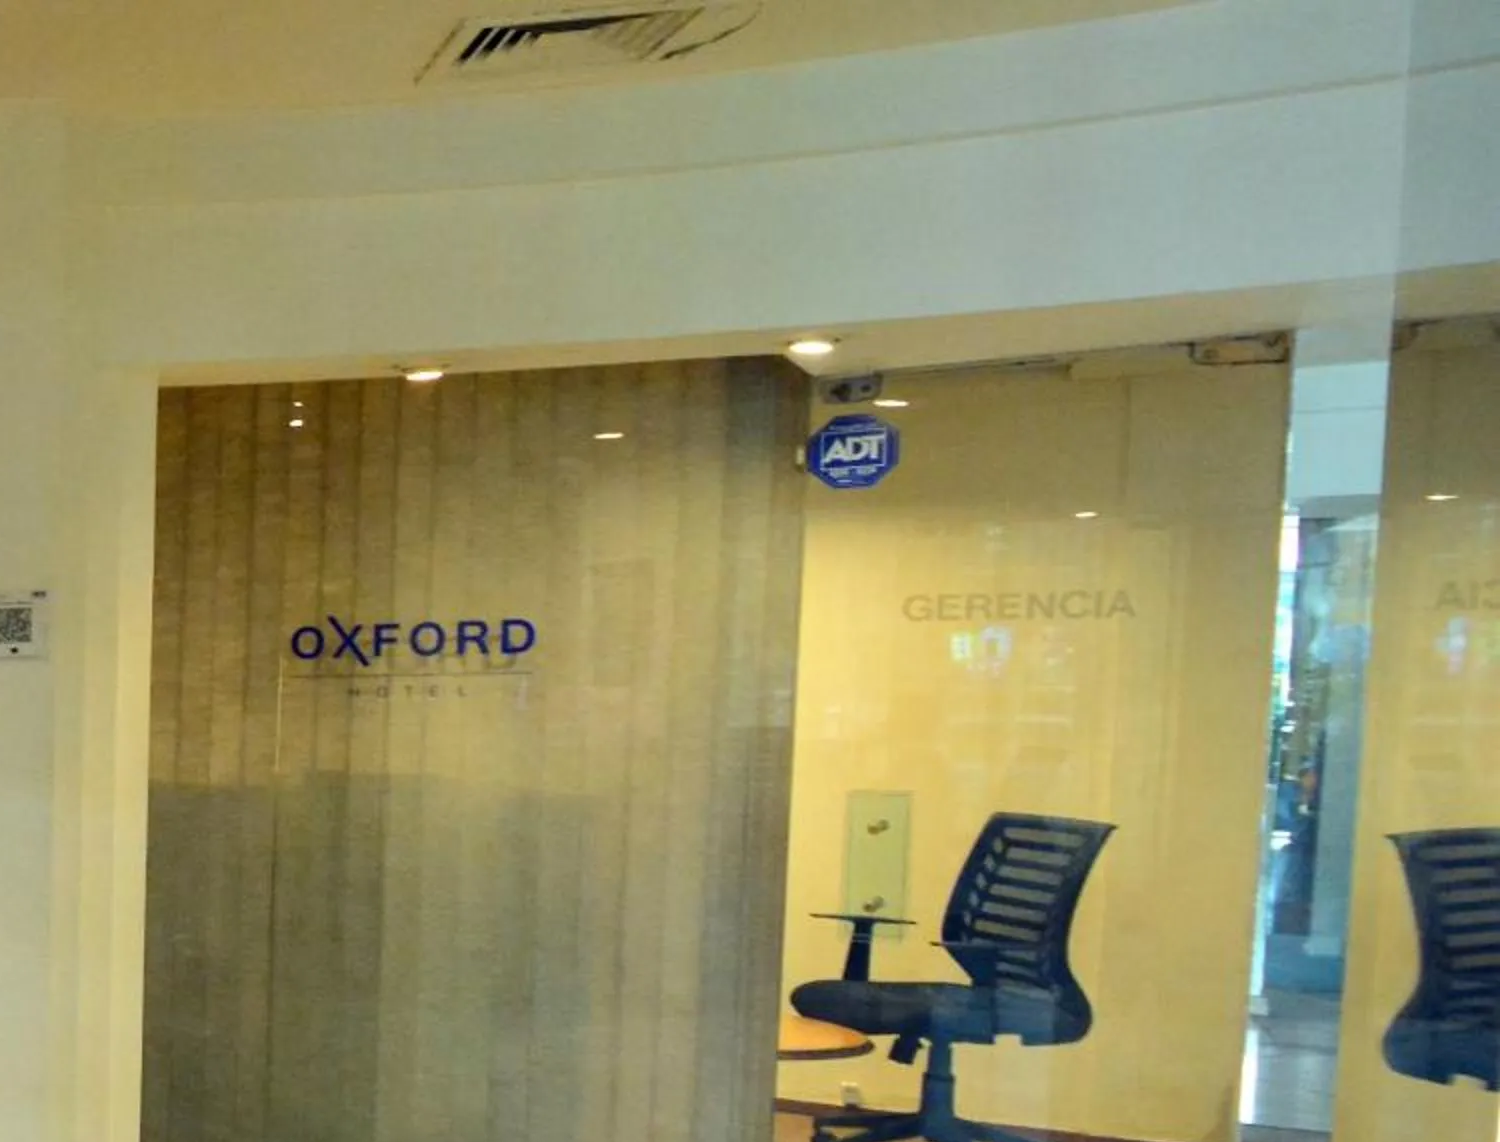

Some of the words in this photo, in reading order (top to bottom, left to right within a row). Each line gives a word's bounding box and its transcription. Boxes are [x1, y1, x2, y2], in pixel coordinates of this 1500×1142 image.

[822, 434, 885, 463] ADT
[901, 589, 1136, 622] GERENCIA
[291, 614, 536, 668] OXFORD
[348, 685, 467, 698] HOTEL
